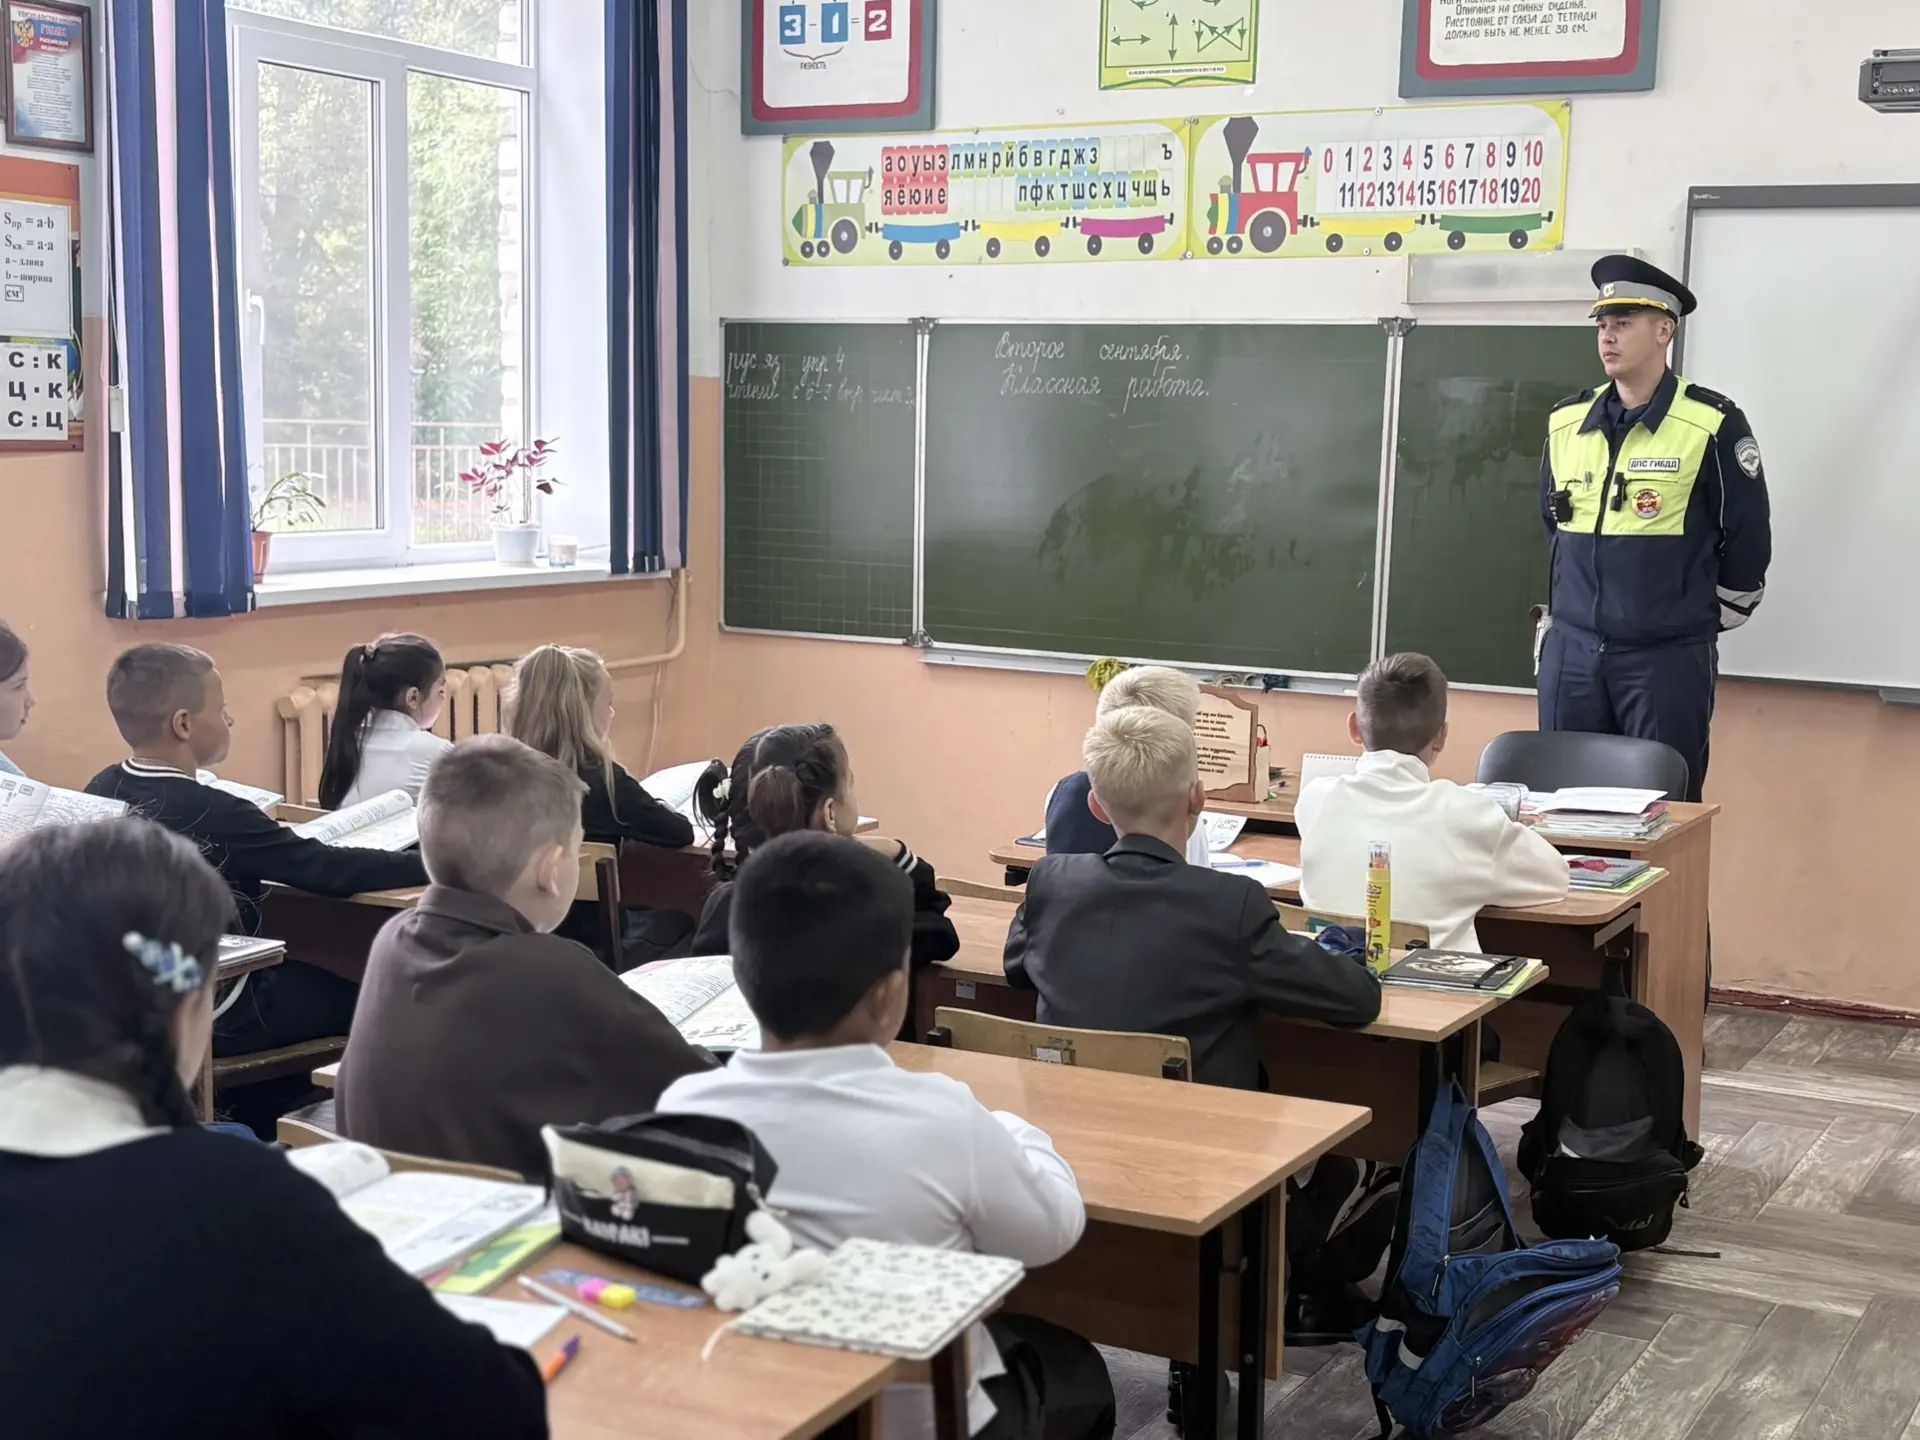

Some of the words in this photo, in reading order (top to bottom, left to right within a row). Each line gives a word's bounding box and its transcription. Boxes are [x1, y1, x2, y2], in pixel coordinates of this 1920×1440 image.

[784, 14, 801, 36] 3
[832, 12, 839, 34] 1
[868, 9, 887, 32] 2
[1498, 16, 1508, 25] ОТ
[1540, 14, 1553, 23] ДО
[1484, 28, 1506, 37] БЫТЬ
[1509, 27, 1520, 36] НЕ
[1555, 24, 1568, 34] 30
[1324, 148, 1333, 173] 0
[1346, 147, 1352, 172] 1
[1363, 147, 1372, 171] 2
[1383, 146, 1392, 171] 3
[1403, 145, 1412, 169] 4
[1424, 145, 1433, 169] 5
[1445, 144, 1454, 168] 6
[1465, 143, 1474, 168] 7
[1486, 142, 1495, 168] 8
[1507, 141, 1516, 167] 9
[1525, 140, 1542, 167] 10
[1340, 183, 1355, 207] 11
[1358, 182, 1375, 206] 12
[1378, 181, 1395, 206] 13
[1398, 181, 1415, 206] 14
[1418, 180, 1435, 205] 15
[1439, 180, 1456, 204] 16
[1459, 179, 1478, 204] 17
[1480, 178, 1498, 203] 18
[1501, 178, 1519, 203] 19
[1521, 177, 1540, 203] 20
[9, 351, 25, 368] С
[47, 353, 62, 369] К
[995, 331, 1065, 372] Второе
[1000, 363, 1101, 395] Классная
[9, 381, 26, 400] Ц
[48, 382, 63, 398] К
[8, 411, 24, 427] С
[46, 412, 63, 431] Ц
[1631, 460, 1648, 468] ДПС
[1650, 460, 1677, 468] ГИБДД
